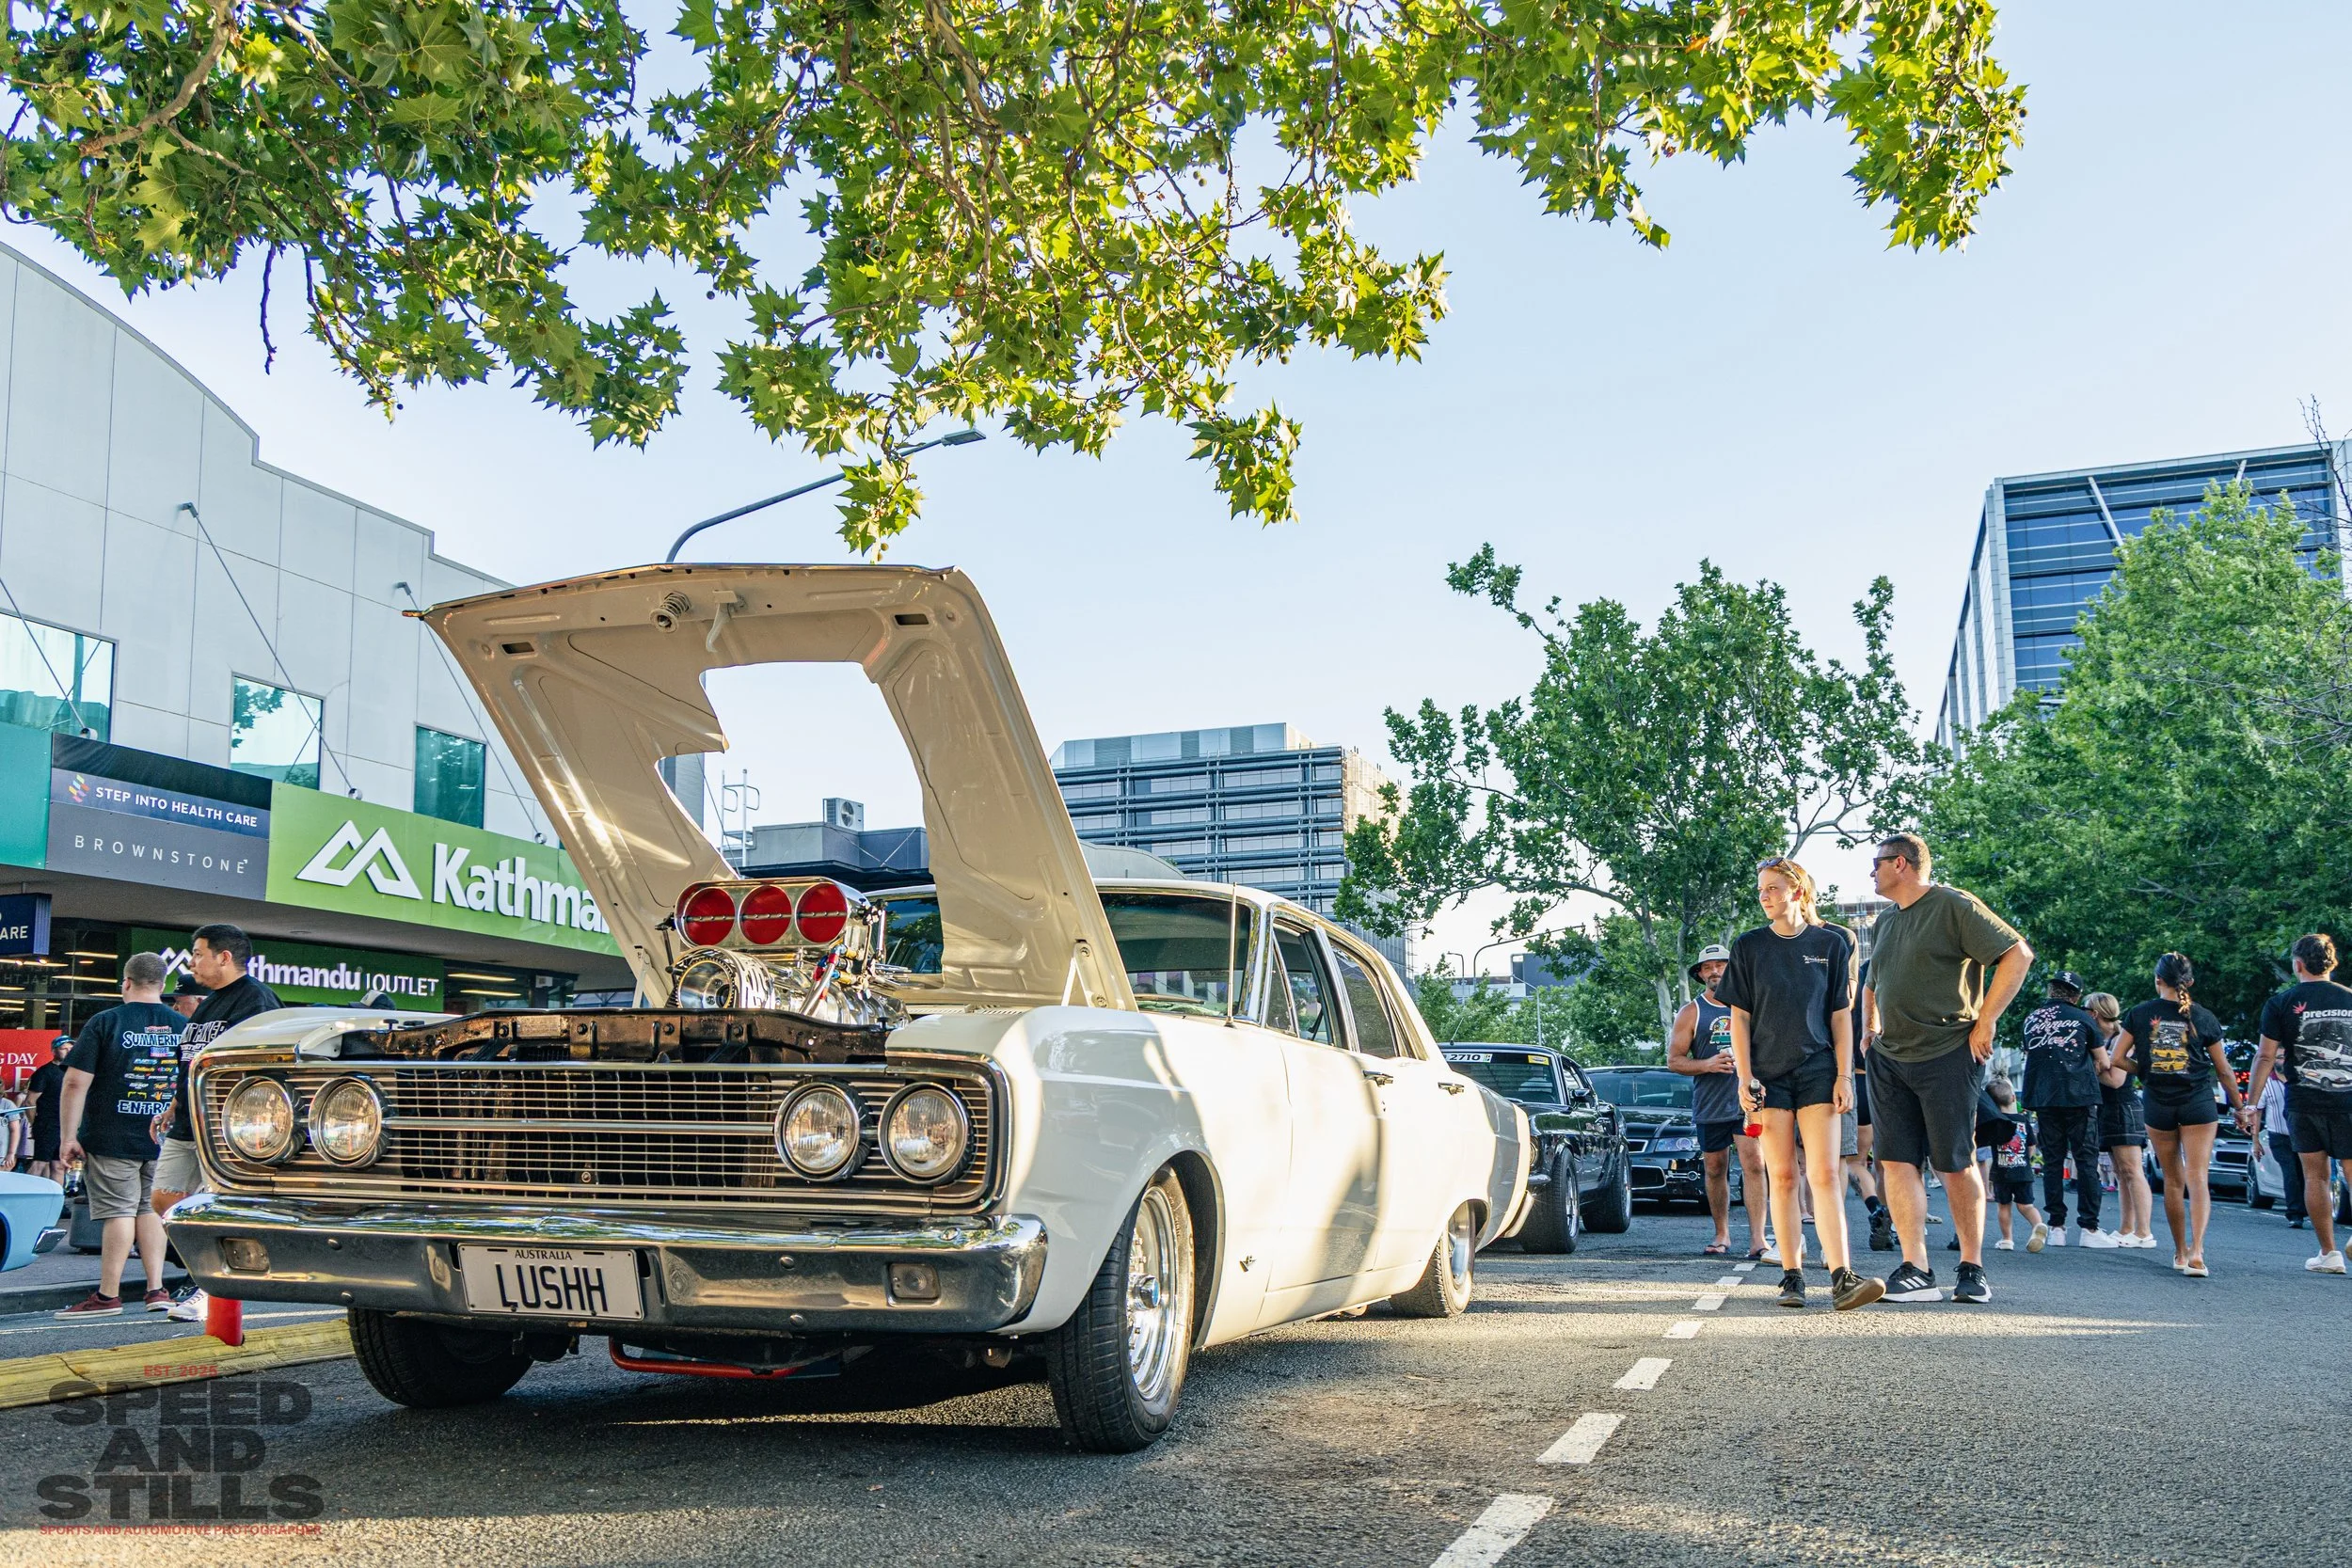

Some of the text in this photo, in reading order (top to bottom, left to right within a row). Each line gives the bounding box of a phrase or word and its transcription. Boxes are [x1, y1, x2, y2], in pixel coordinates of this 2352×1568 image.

[95, 786, 258, 828] STEP INTO HEALTH CARE
[75, 834, 246, 874] BROWNSTONE
[247, 955, 439, 997] thmandu OUTLET
[8, 1053, 38, 1064] DAY
[515, 1249, 572, 1260] AUSTRALIA
[495, 1264, 608, 1312] LUSHH
